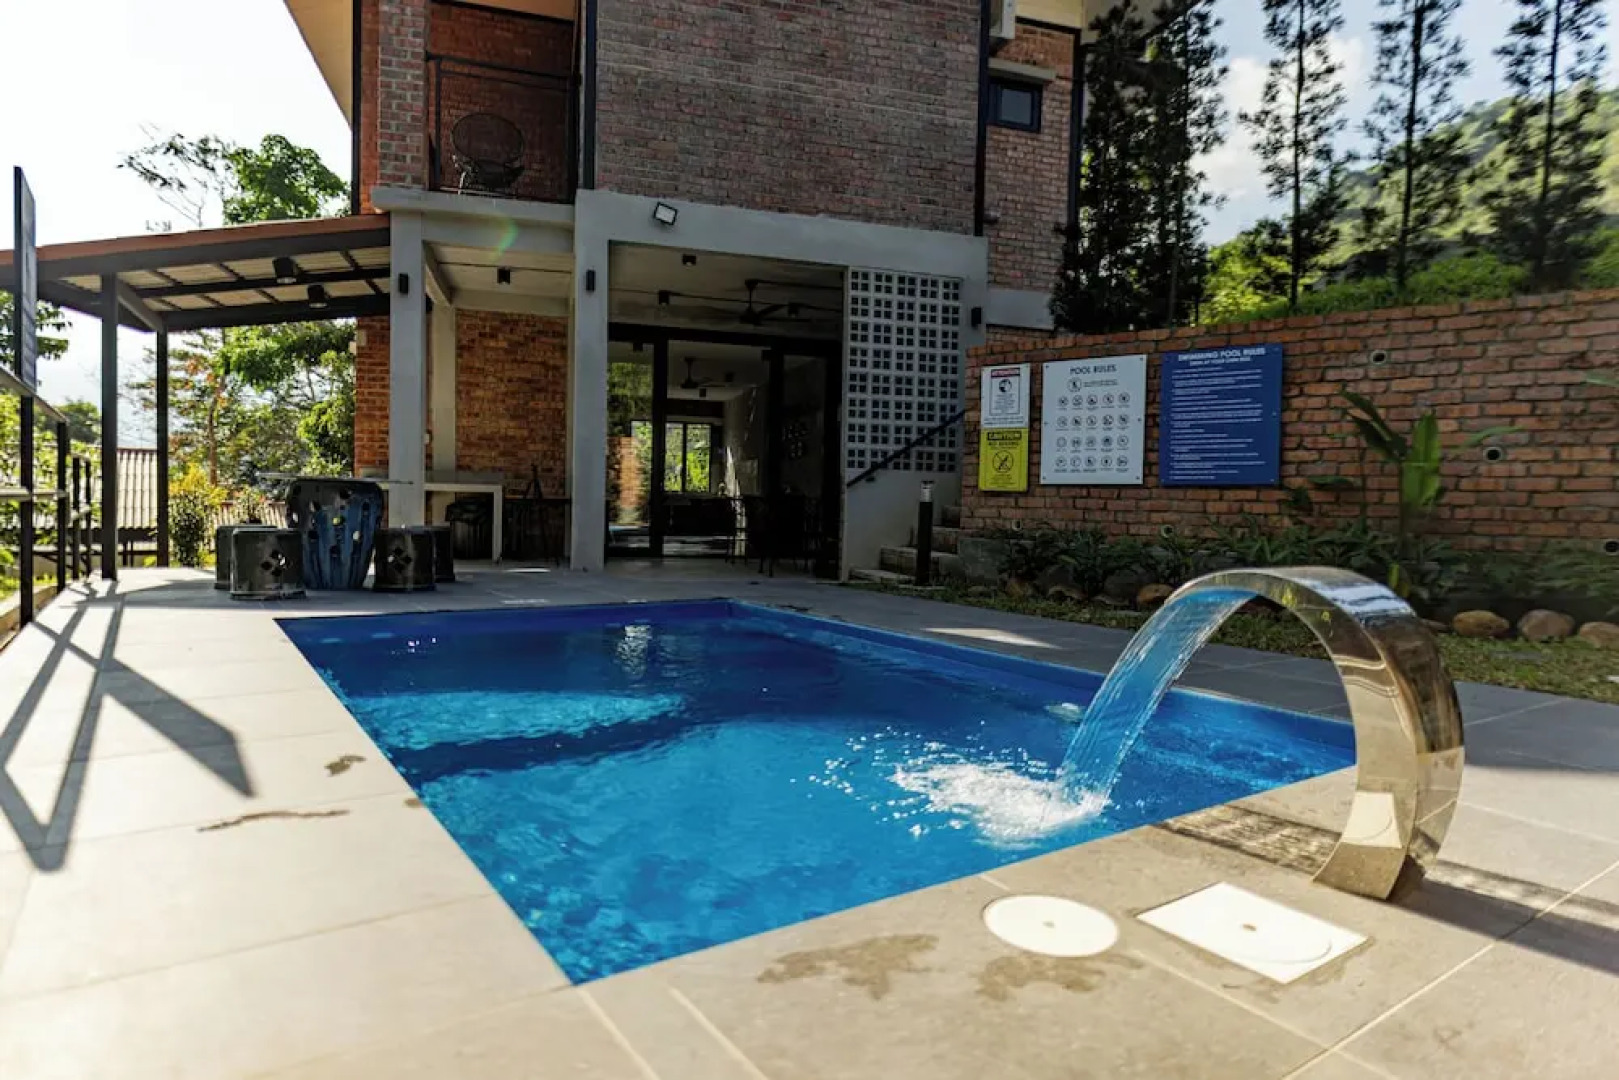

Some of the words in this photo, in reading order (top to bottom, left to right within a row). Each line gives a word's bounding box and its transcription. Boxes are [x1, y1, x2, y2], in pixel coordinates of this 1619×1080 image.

[1220, 349, 1241, 357] POOL
[1069, 365, 1091, 375] POOL
[1093, 363, 1118, 373] RULES
